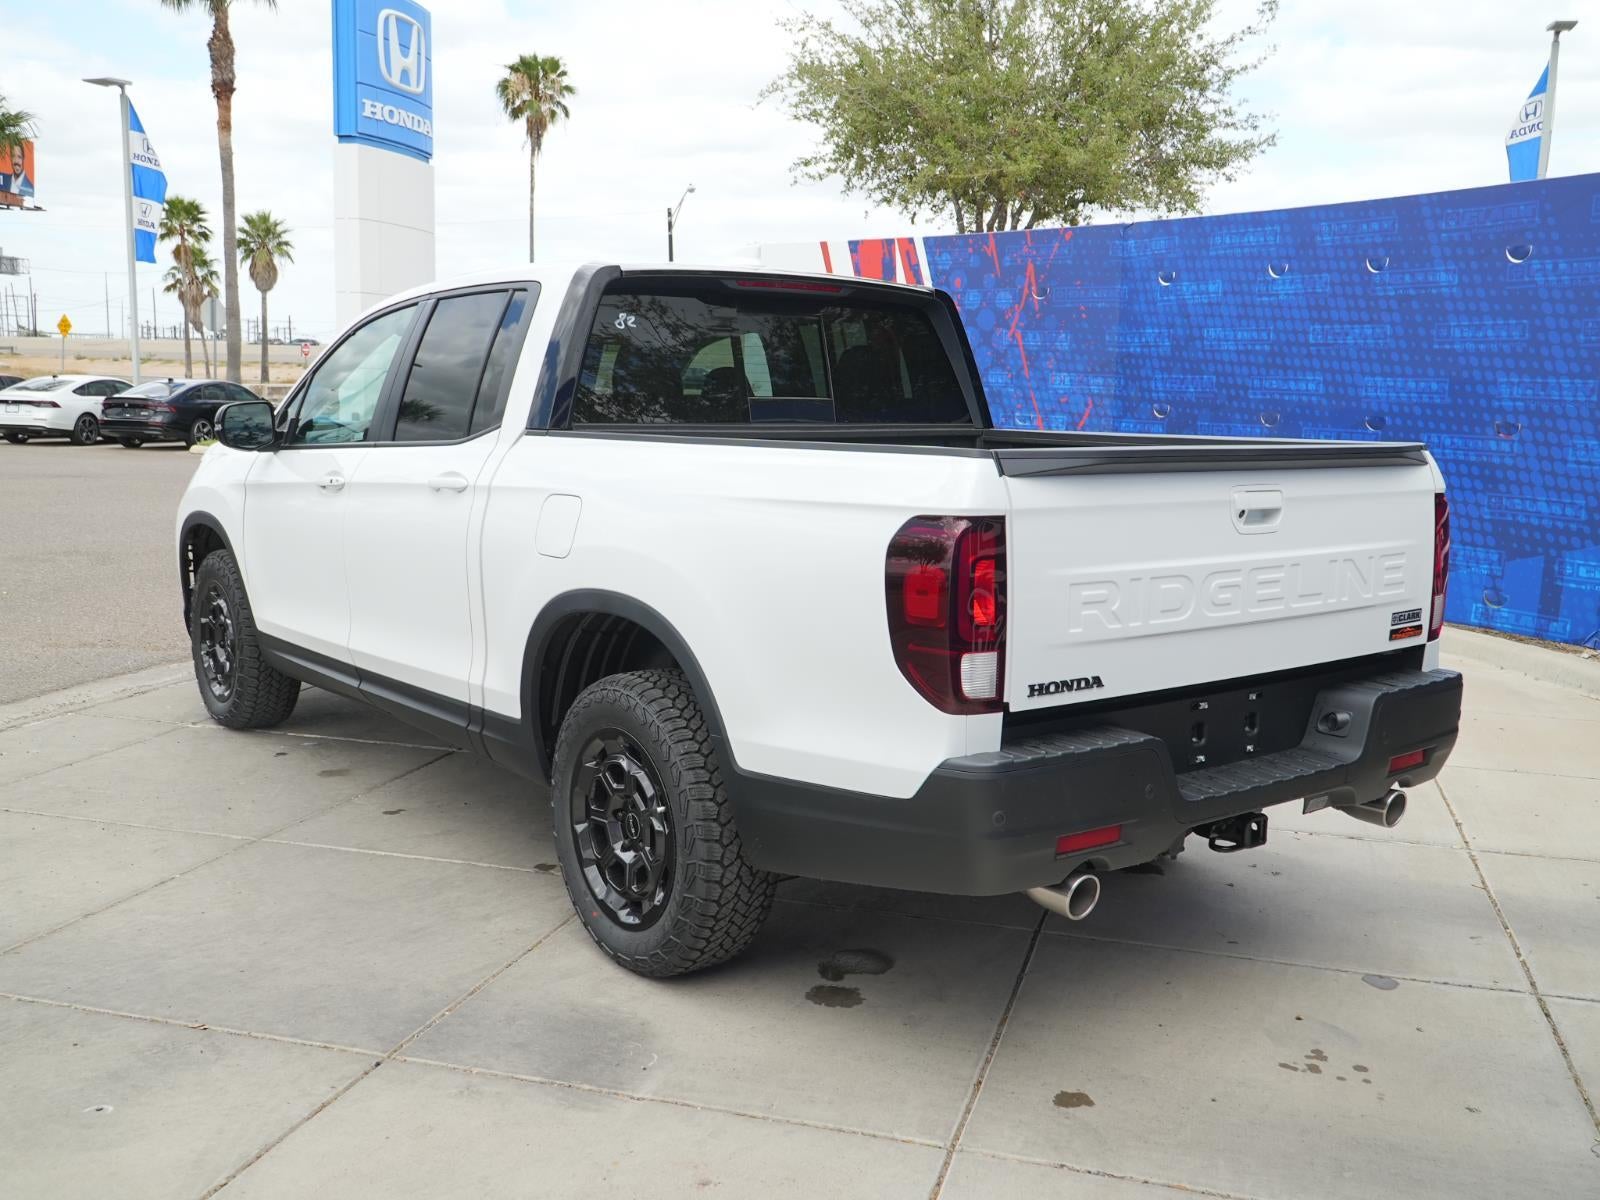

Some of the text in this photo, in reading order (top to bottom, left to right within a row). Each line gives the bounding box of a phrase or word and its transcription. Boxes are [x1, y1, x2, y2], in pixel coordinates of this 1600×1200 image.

[362, 98, 432, 138] HONDA
[133, 153, 160, 167] HOND
[614, 312, 637, 329] 82
[1068, 552, 1406, 633] RIDGELINE
[1027, 676, 1104, 698] HONDA
